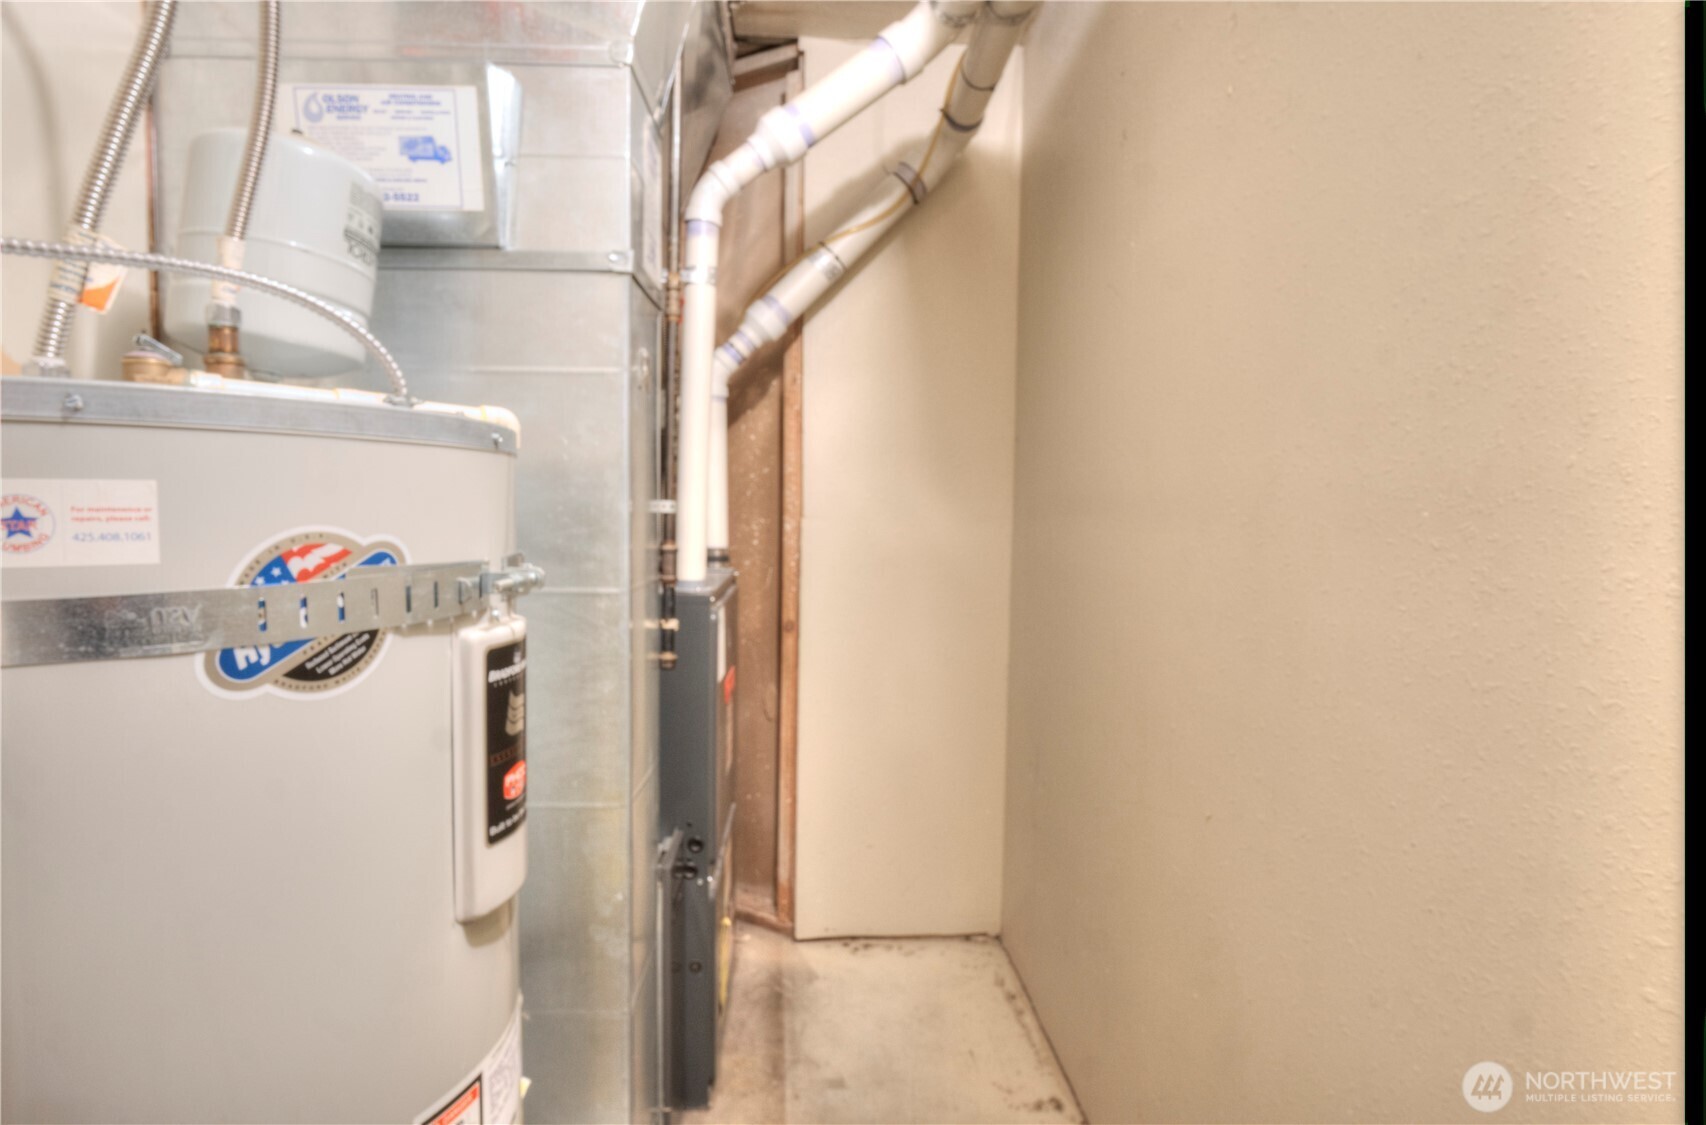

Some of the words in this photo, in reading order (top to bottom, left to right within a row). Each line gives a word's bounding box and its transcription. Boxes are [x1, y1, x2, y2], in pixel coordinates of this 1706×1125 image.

[326, 104, 368, 113] ENERGY
[71, 515, 103, 523] repairs,
[105, 515, 132, 523] please
